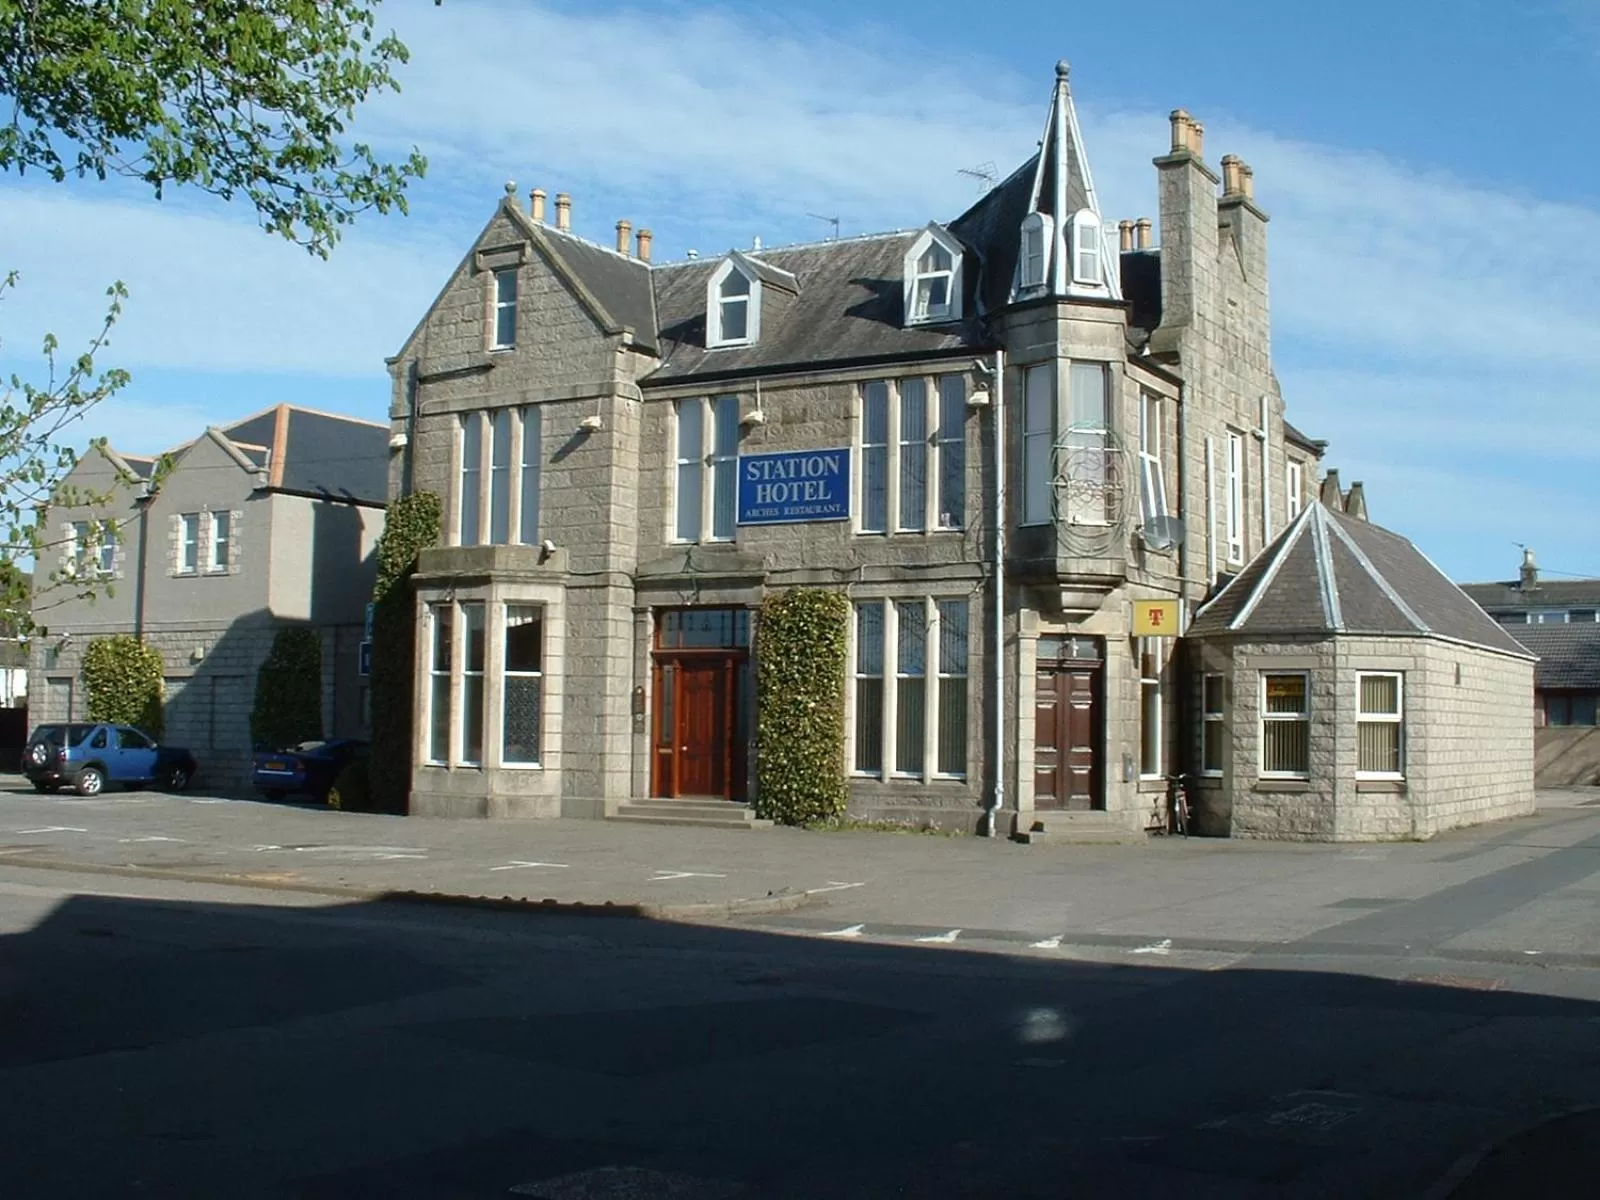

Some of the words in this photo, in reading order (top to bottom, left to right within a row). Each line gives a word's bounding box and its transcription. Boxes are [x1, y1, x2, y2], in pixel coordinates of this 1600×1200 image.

[746, 456, 839, 480] STATION
[756, 480, 831, 504] HOTEL
[783, 503, 841, 515] RESTAURANT
[1149, 609, 1164, 626] T
